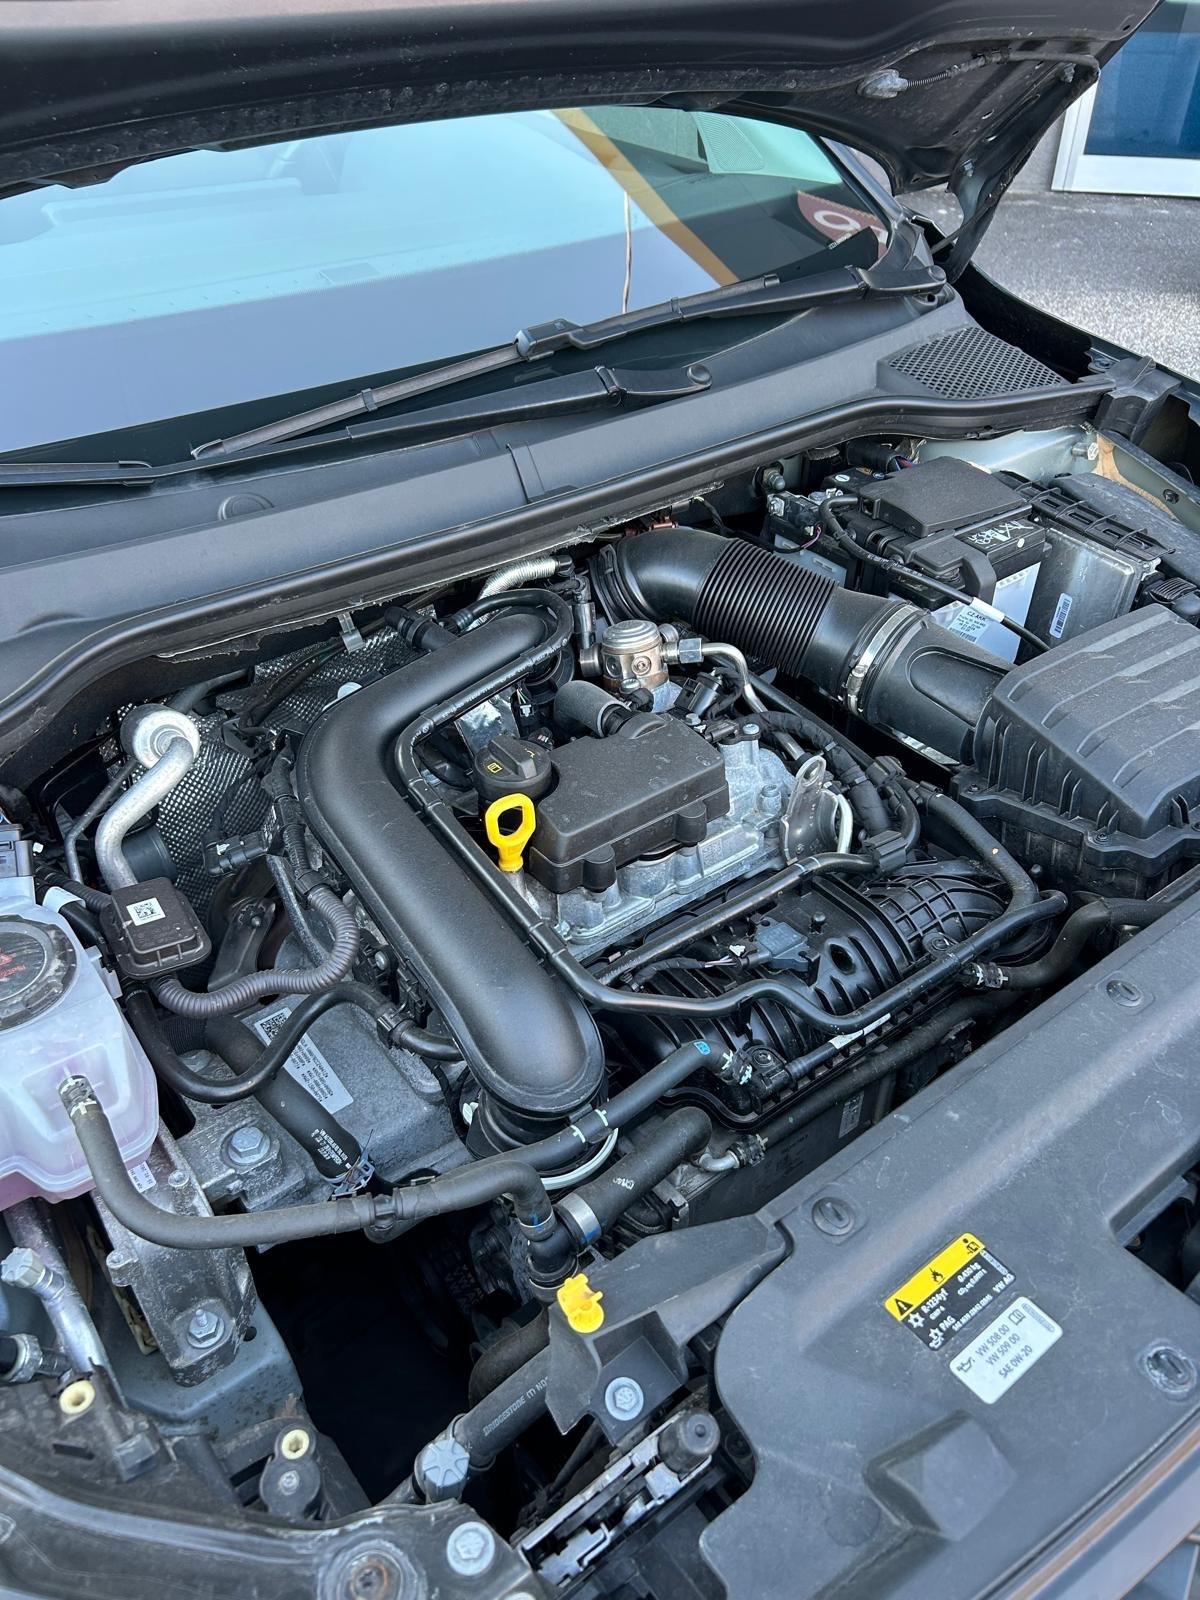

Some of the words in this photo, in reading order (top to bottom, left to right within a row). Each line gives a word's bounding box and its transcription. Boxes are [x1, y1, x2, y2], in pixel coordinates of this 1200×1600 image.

[970, 1262, 981, 1271] kg
[992, 1280, 1006, 1293] VW
[1003, 1273, 1015, 1286] AG
[921, 1287, 948, 1313] R-1234yf
[939, 1315, 956, 1331] PAG
[952, 1321, 963, 1331] SAE
[975, 1343, 990, 1357] VW
[986, 1332, 1001, 1347] 508
[998, 1324, 1010, 1335] 00
[985, 1352, 1000, 1366] VW
[996, 1341, 1012, 1356] 509
[1008, 1333, 1020, 1345] 00
[998, 1363, 1014, 1378] SAE
[1010, 1344, 1033, 1367] 0W-20
[482, 1395, 526, 1435] BRIDGESTONE
